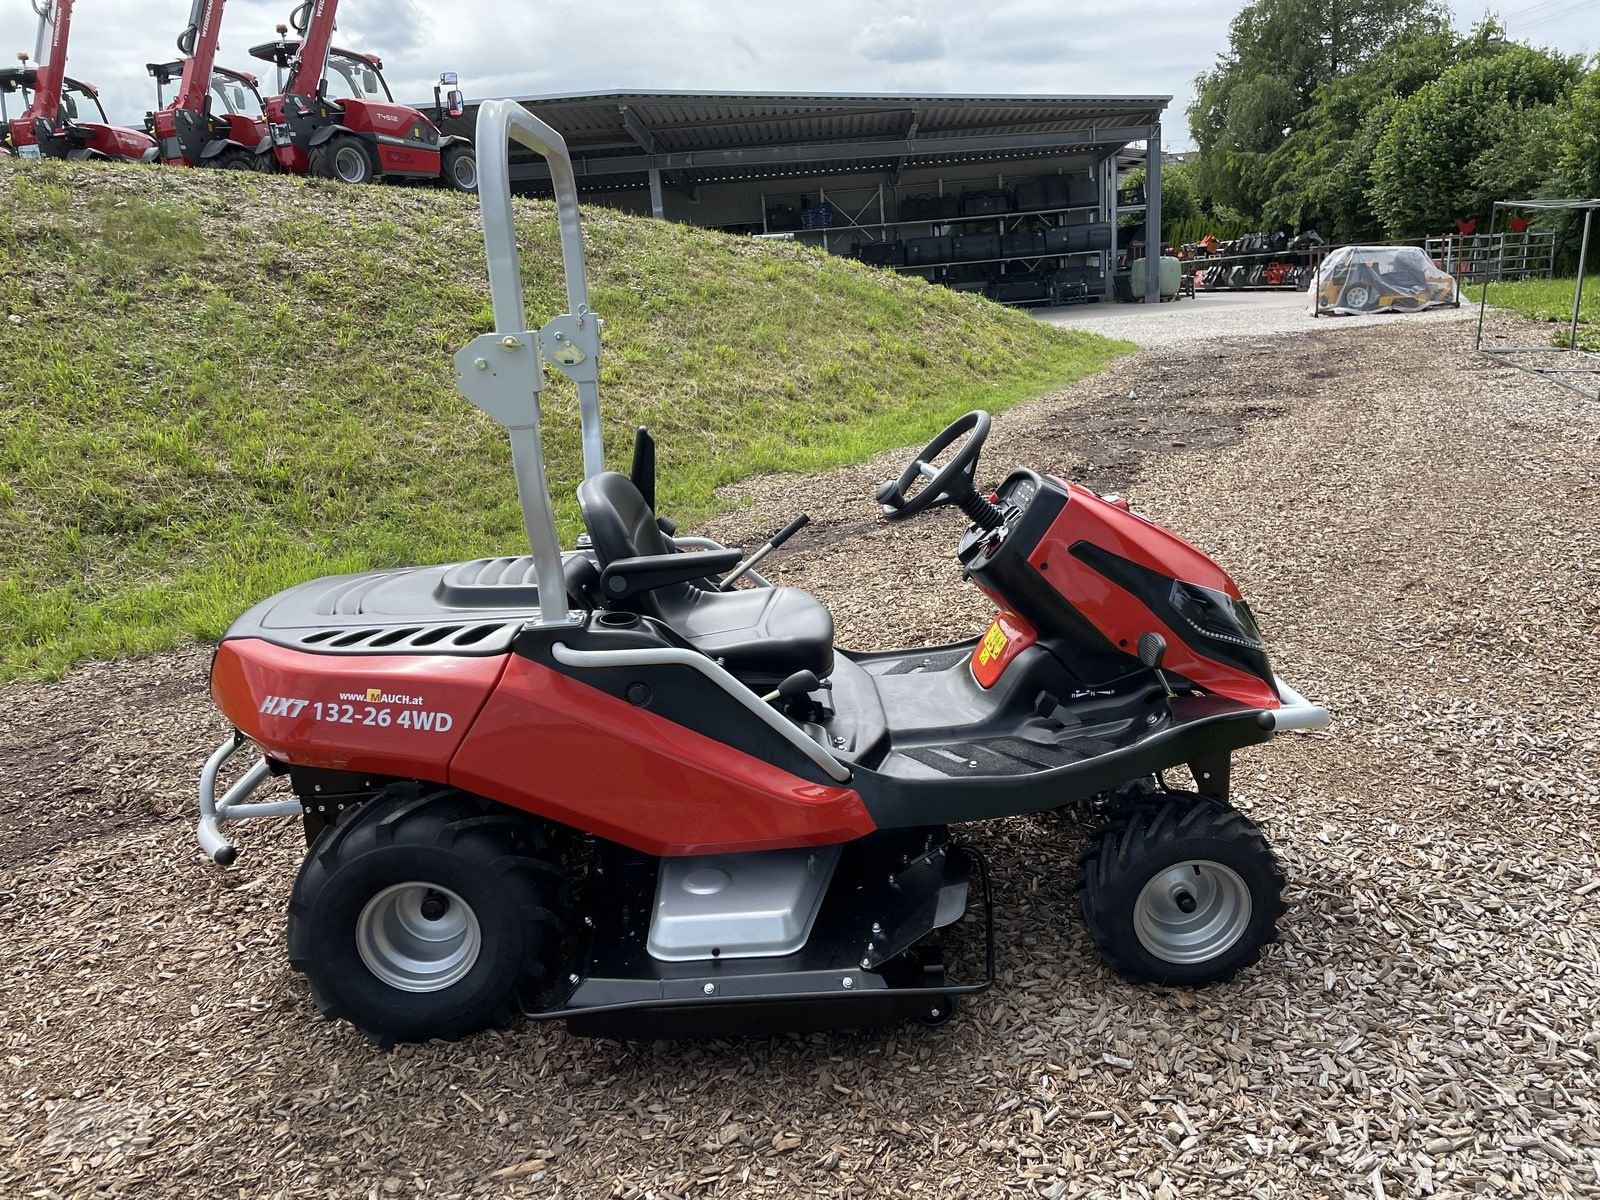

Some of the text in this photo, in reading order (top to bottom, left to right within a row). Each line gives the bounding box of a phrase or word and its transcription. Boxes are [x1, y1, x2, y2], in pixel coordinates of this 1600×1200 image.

[53, 6, 62, 47] WEIDEMANN
[258, 695, 453, 732] HXT 132-26 4WD
[339, 690, 424, 705] www.MAUCH.at
